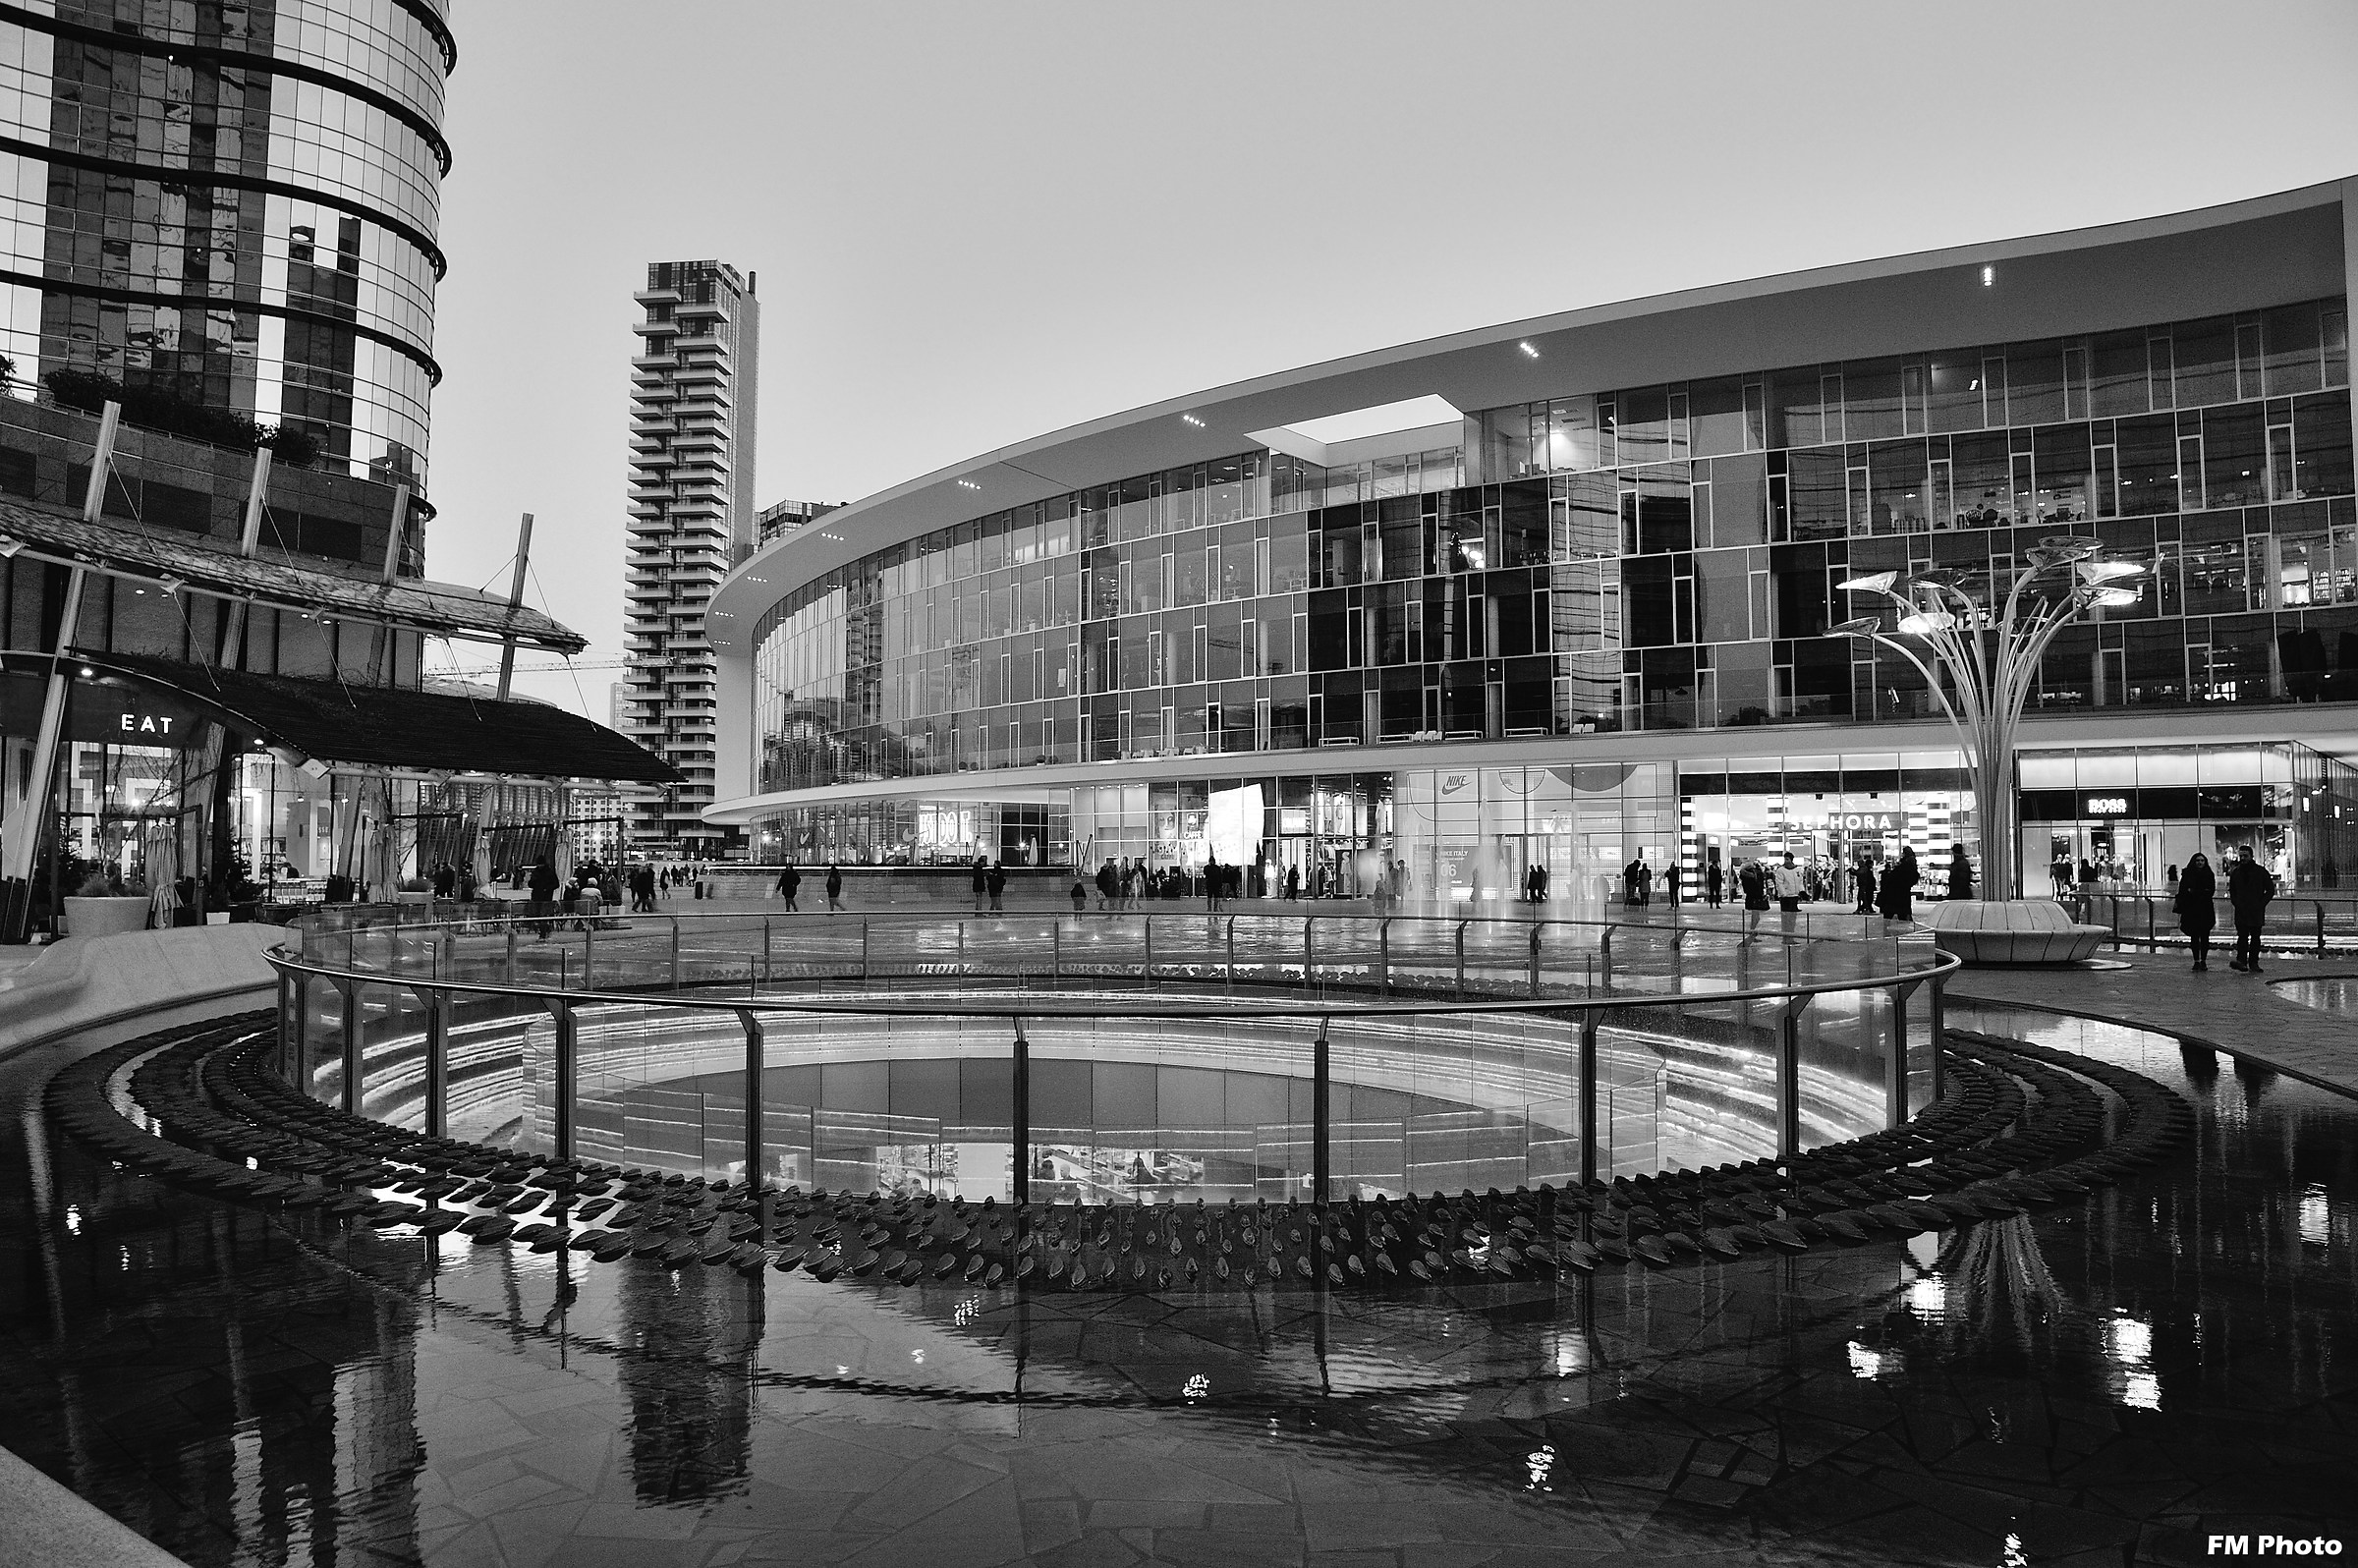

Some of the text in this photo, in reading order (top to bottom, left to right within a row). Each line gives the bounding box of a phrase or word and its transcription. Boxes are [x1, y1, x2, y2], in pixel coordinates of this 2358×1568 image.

[121, 713, 173, 734] EAT
[1446, 775, 1467, 786] NIKE
[2088, 798, 2127, 812] BOSS
[1790, 814, 1892, 830] SEPHORA
[1440, 864, 1457, 877] 06
